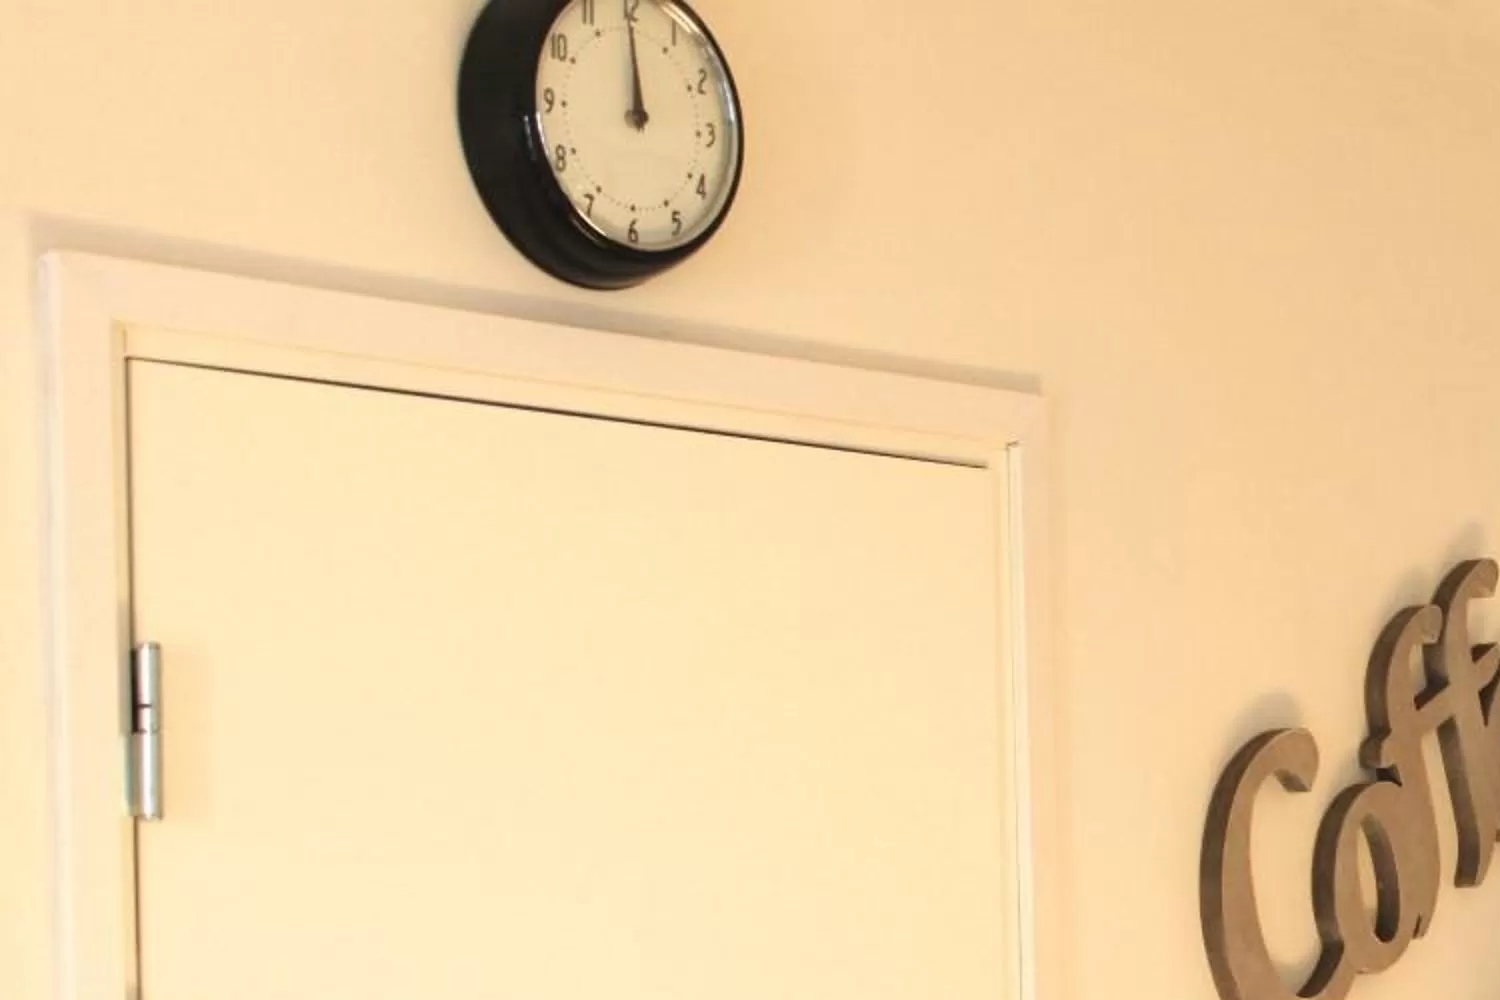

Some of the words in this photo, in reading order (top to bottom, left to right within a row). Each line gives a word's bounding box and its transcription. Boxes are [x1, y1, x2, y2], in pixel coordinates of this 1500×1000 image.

[550, 33, 568, 61] 10
[697, 69, 708, 95] 2
[543, 87, 555, 113] 9
[705, 123, 716, 148] 3
[554, 144, 566, 172] 8
[696, 174, 707, 200] 4
[583, 193, 595, 218] 7
[628, 219, 639, 244] 6
[671, 211, 682, 237] 5
